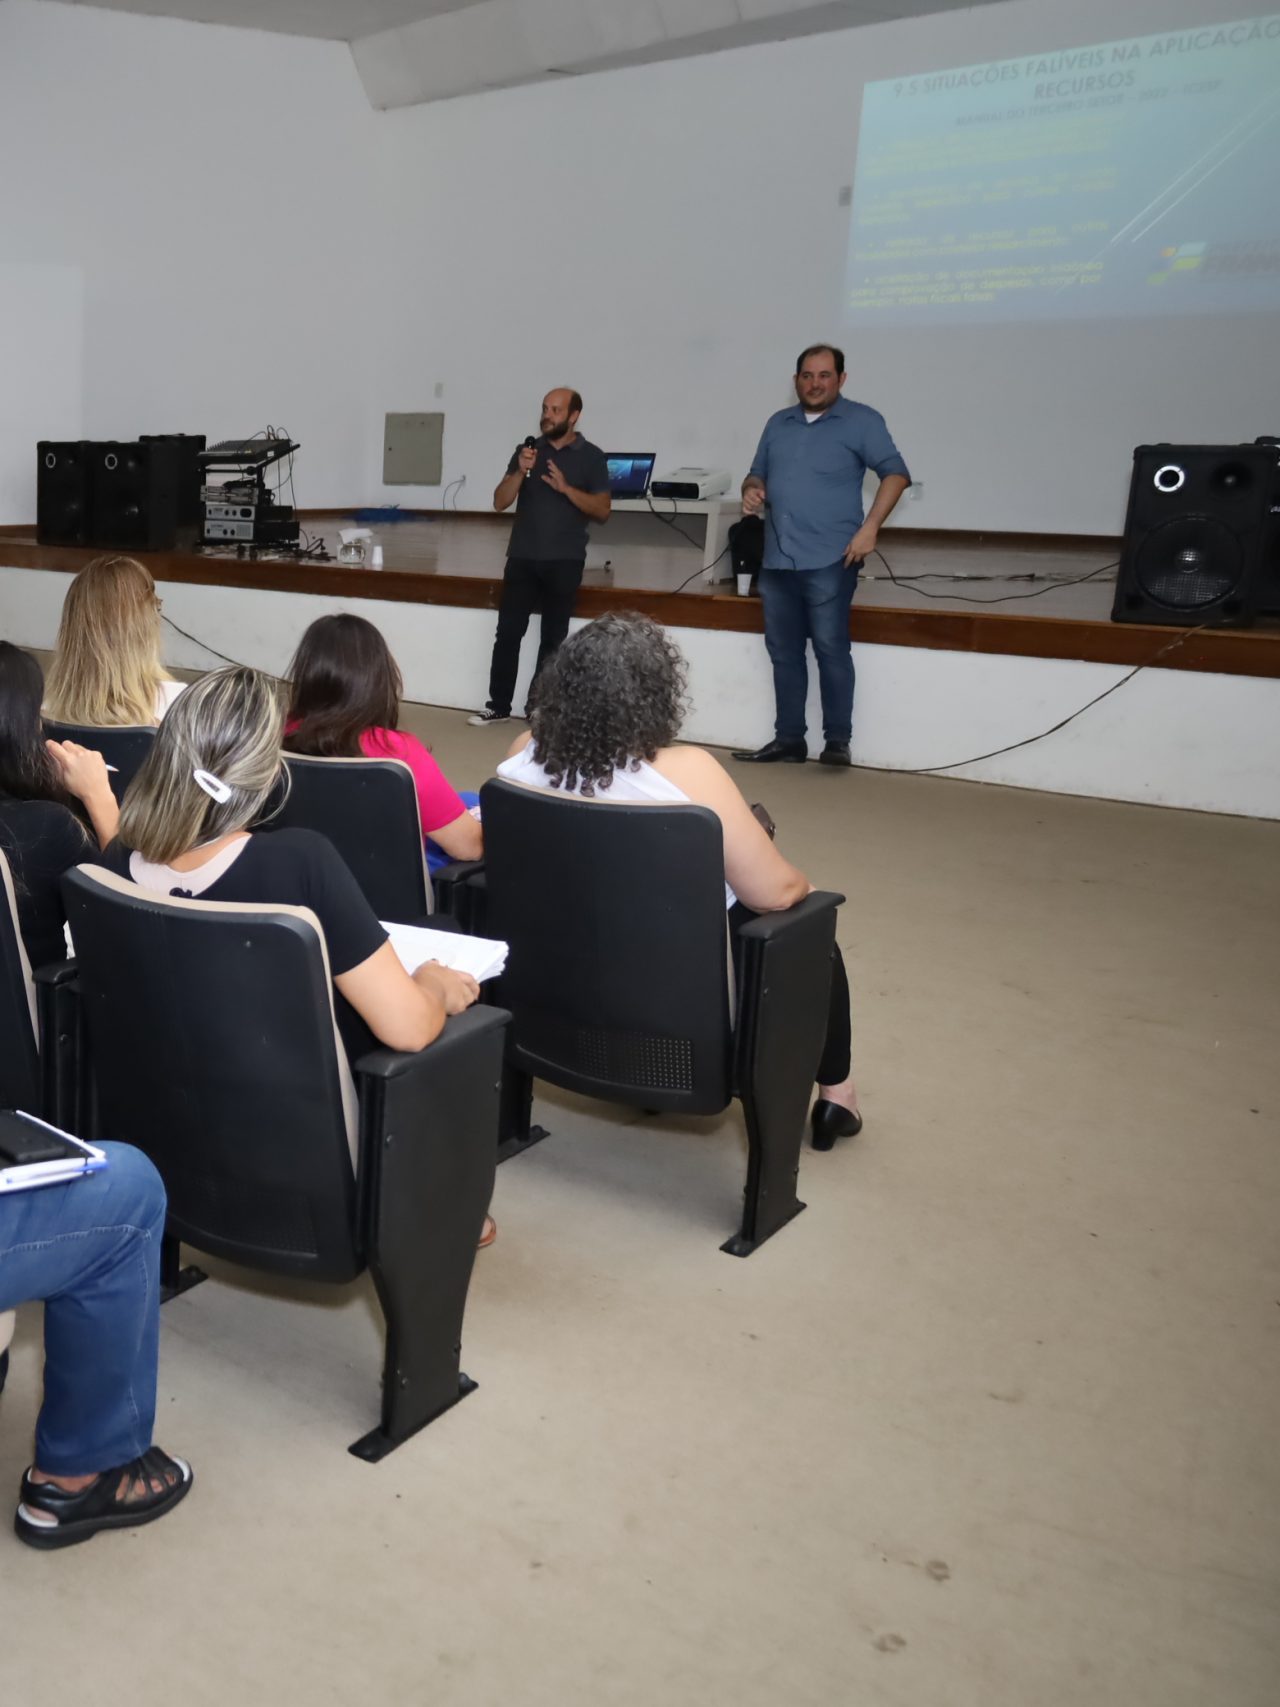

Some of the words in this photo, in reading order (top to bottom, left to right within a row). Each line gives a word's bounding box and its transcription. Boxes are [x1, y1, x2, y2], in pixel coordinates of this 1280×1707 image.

[922, 61, 1020, 95] SITUAÇÕES
[1024, 47, 1105, 79] FALÍVEIS
[1111, 44, 1141, 63] NA
[1033, 69, 1136, 101] RECURSOS
